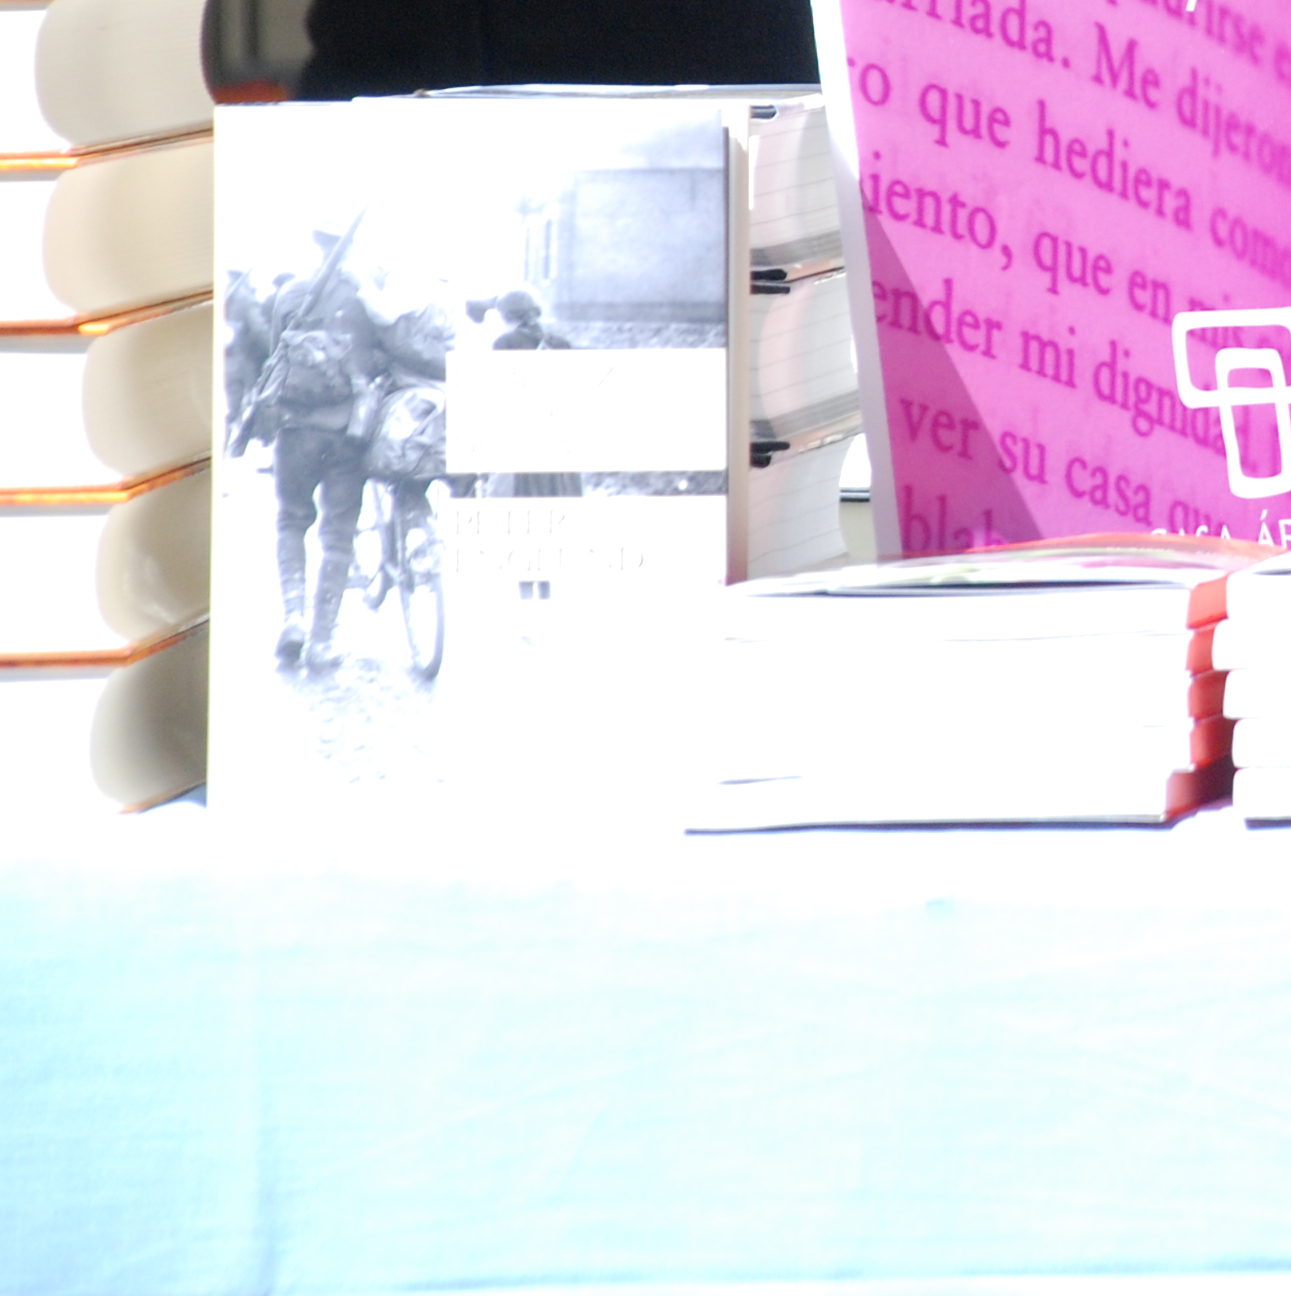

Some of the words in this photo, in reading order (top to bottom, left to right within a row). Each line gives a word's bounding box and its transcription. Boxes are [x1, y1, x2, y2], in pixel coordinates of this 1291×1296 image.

[1091, 19, 1162, 110] Me
[918, 82, 1012, 149] que
[1034, 98, 1195, 232] hediera
[1033, 231, 1114, 296] que
[1019, 325, 1077, 390] mi
[900, 396, 980, 461] ver
[997, 429, 1048, 486] su
[1065, 456, 1153, 528] casa
